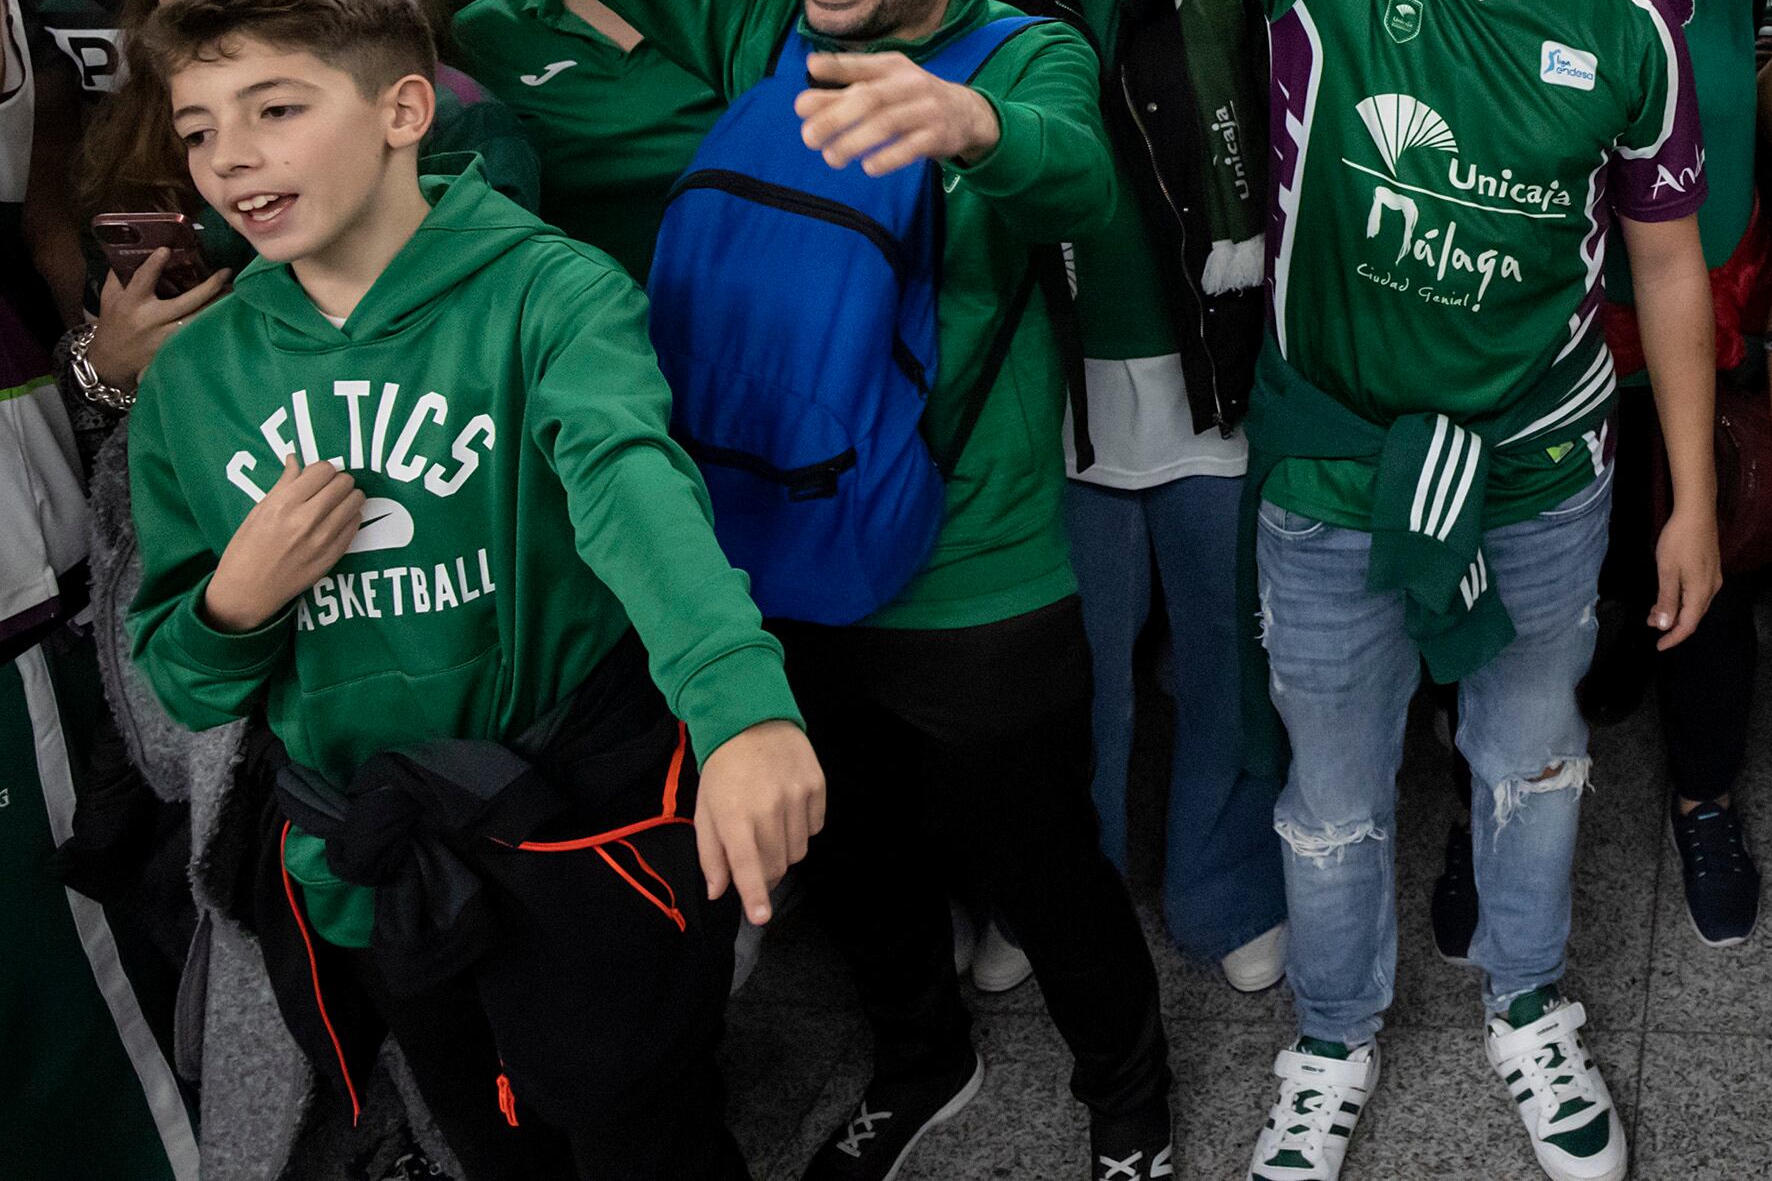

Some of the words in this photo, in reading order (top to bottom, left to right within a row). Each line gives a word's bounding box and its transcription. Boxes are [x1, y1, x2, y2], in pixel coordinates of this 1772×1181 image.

[1556, 67, 1593, 81] endesa
[1212, 105, 1250, 199] Unicaja
[1448, 157, 1572, 210] Unicaja
[1366, 186, 1523, 313] Málaga
[1357, 263, 1410, 292] Ciudad
[1418, 286, 1471, 307] Genial
[298, 548, 496, 631] ASKETBALL
